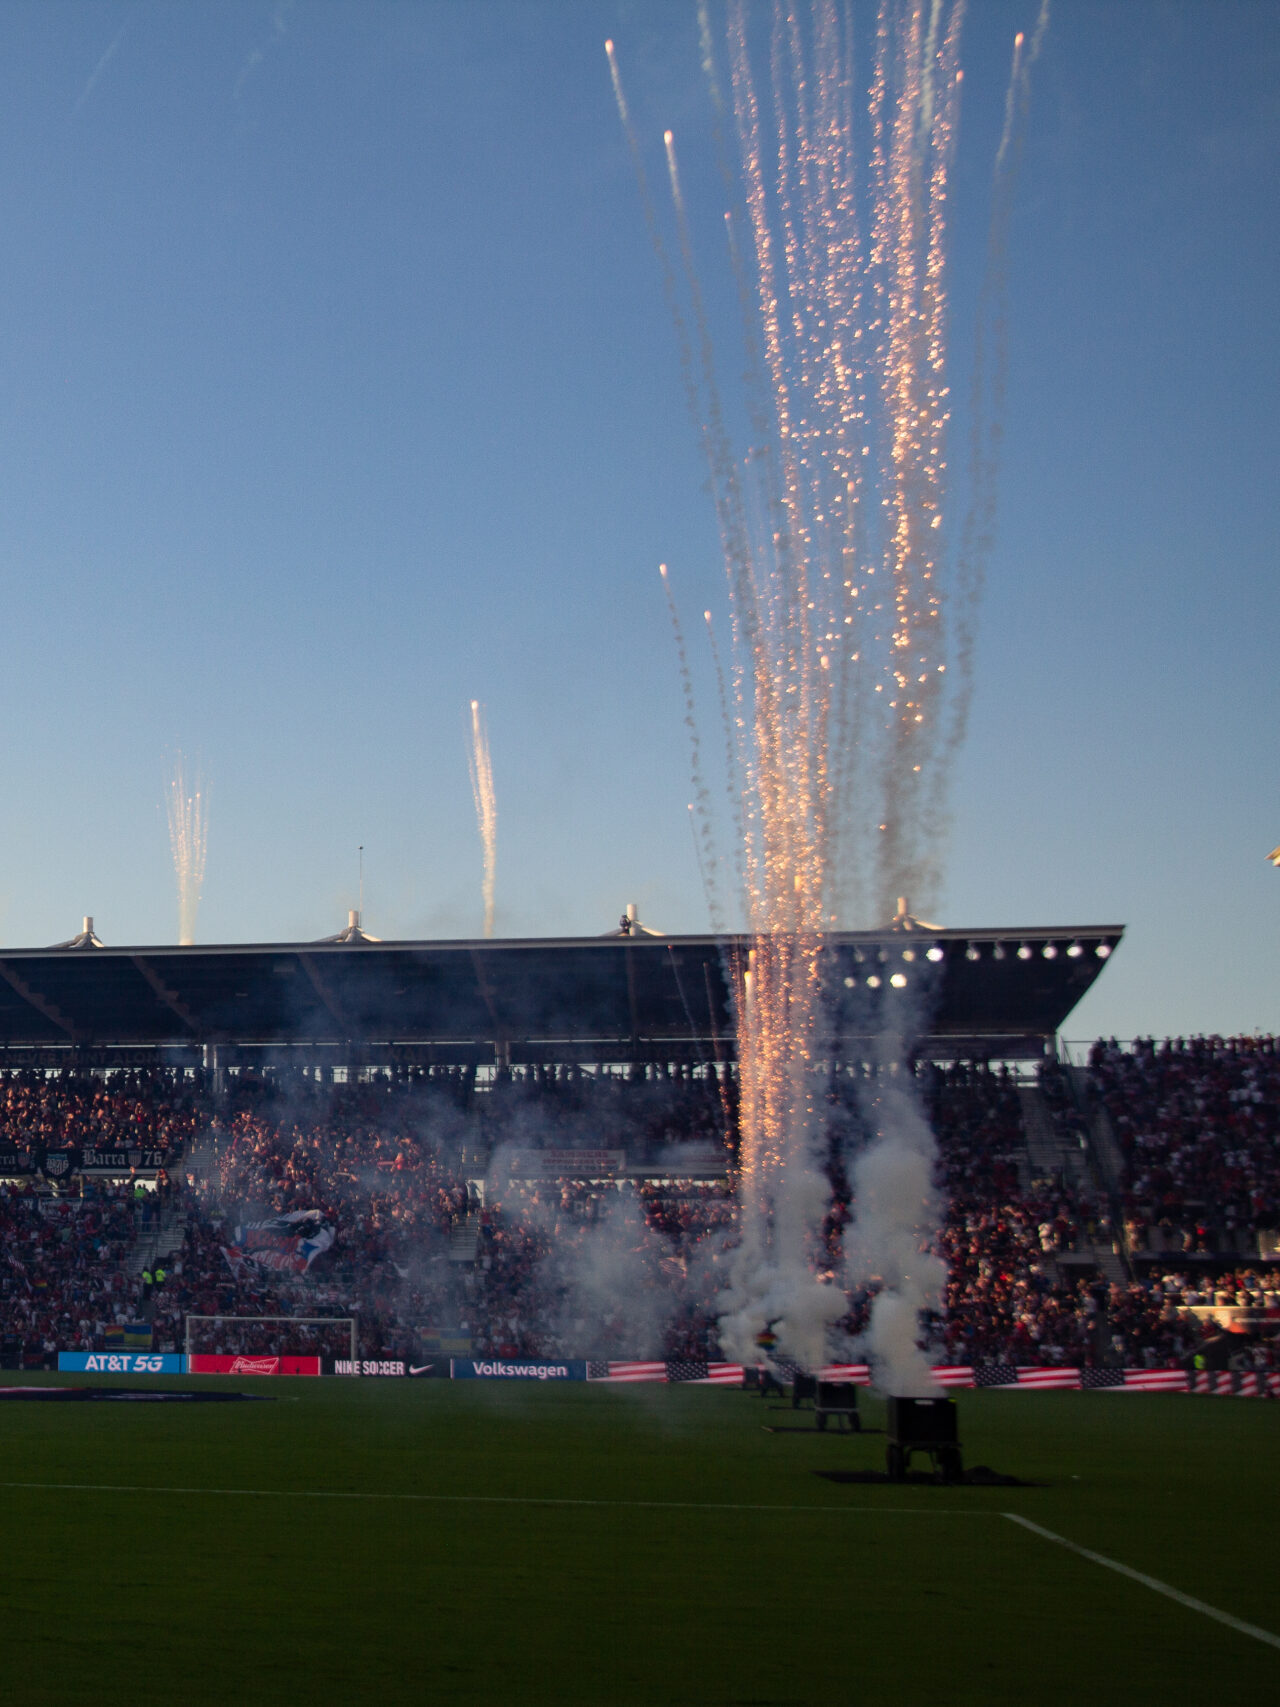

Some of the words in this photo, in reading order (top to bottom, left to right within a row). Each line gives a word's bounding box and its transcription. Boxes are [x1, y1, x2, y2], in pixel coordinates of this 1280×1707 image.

[82, 1149, 126, 1166] Barra
[144, 1150, 163, 1165] 76
[85, 1355, 131, 1371] AT&T
[132, 1356, 164, 1372] 5G
[334, 1359, 360, 1375] NIKE
[363, 1360, 405, 1376] SOCCER
[472, 1361, 567, 1380] Volkswagen
